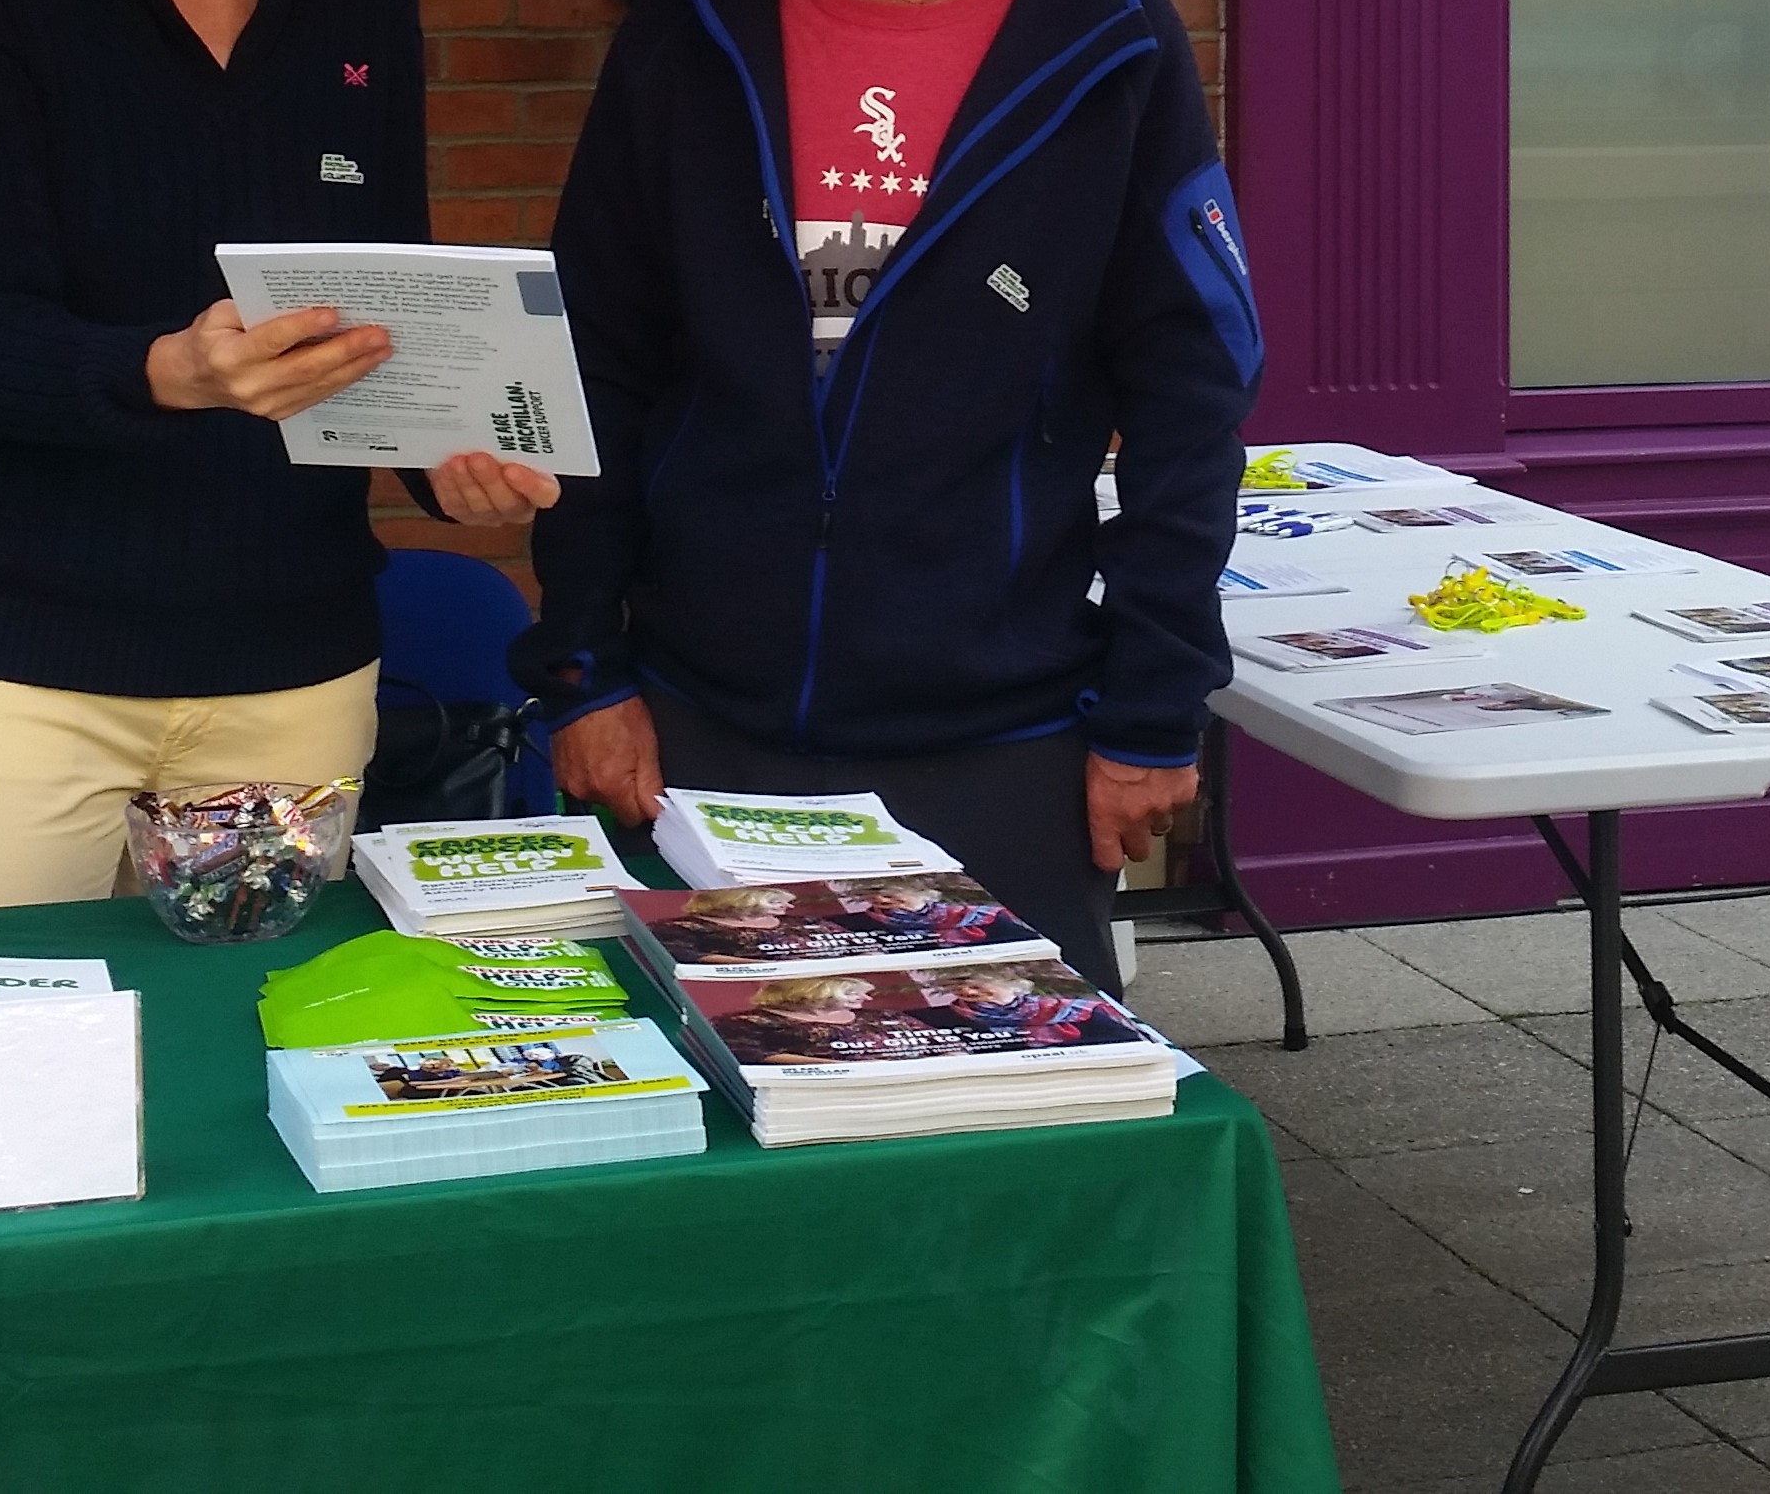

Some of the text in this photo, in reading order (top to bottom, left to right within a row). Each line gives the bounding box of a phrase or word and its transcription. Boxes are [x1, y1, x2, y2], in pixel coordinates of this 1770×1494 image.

[529, 391, 554, 454] CANCER SUPPORT
[490, 413, 517, 451] WE ARE
[716, 817, 864, 836] WE CAN
[734, 828, 852, 845] HELP
[422, 848, 573, 866] WE CAN
[440, 859, 557, 877] HELP
[458, 943, 535, 953] HELP
[465, 964, 542, 975] HELPING
[481, 973, 561, 982] HELP
[830, 1041, 876, 1049] Our
[883, 1037, 930, 1046] Gift
[962, 1031, 1012, 1040] You
